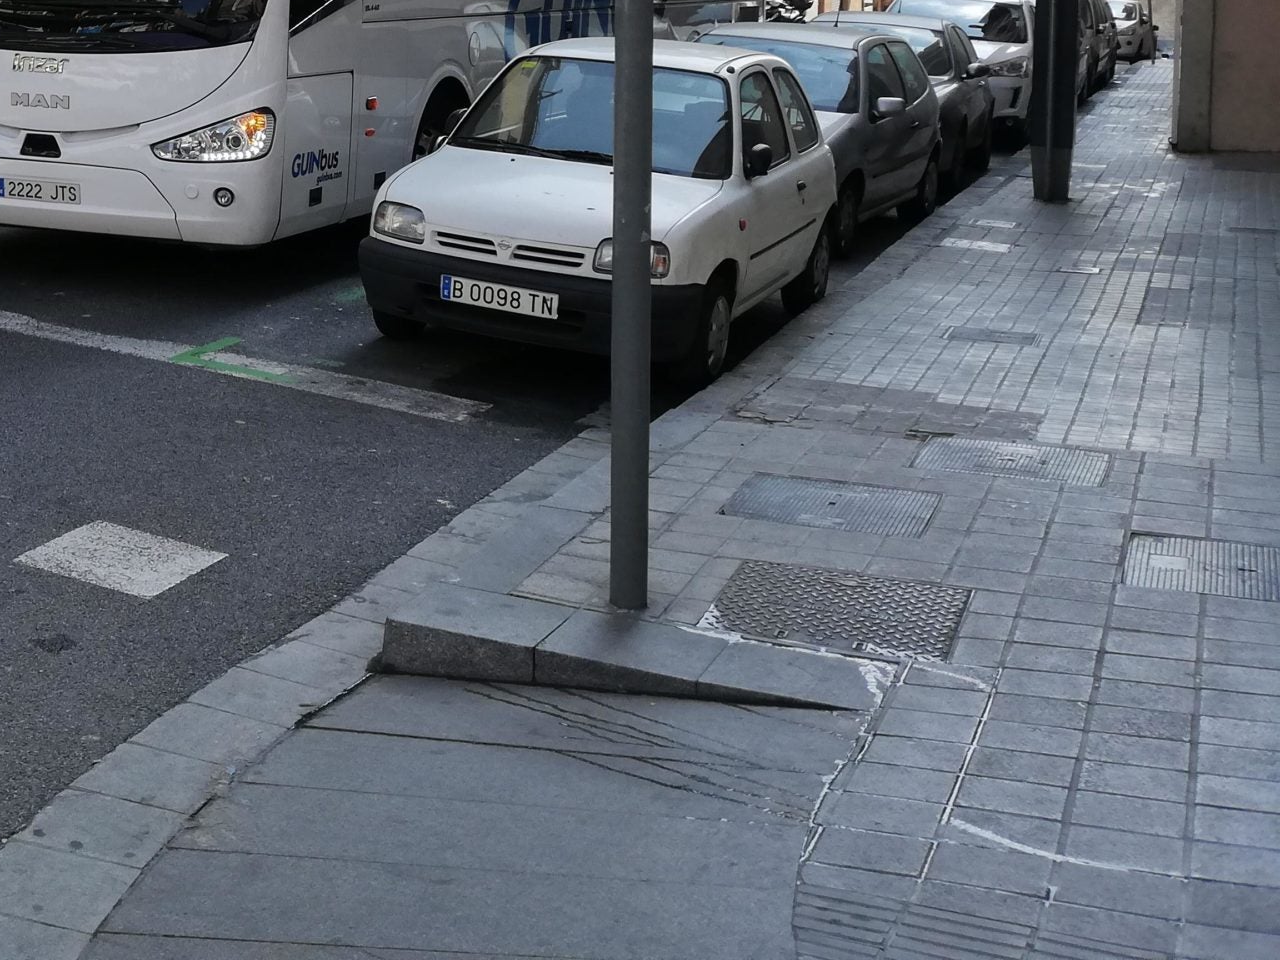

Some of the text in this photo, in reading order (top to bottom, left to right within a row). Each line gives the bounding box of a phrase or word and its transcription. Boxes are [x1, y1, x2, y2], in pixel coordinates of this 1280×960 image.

[10, 91, 71, 110] MAN
[291, 148, 340, 178] GUINbus
[7, 180, 77, 202] 2222 JTS
[452, 279, 554, 316] B 0098 TN
